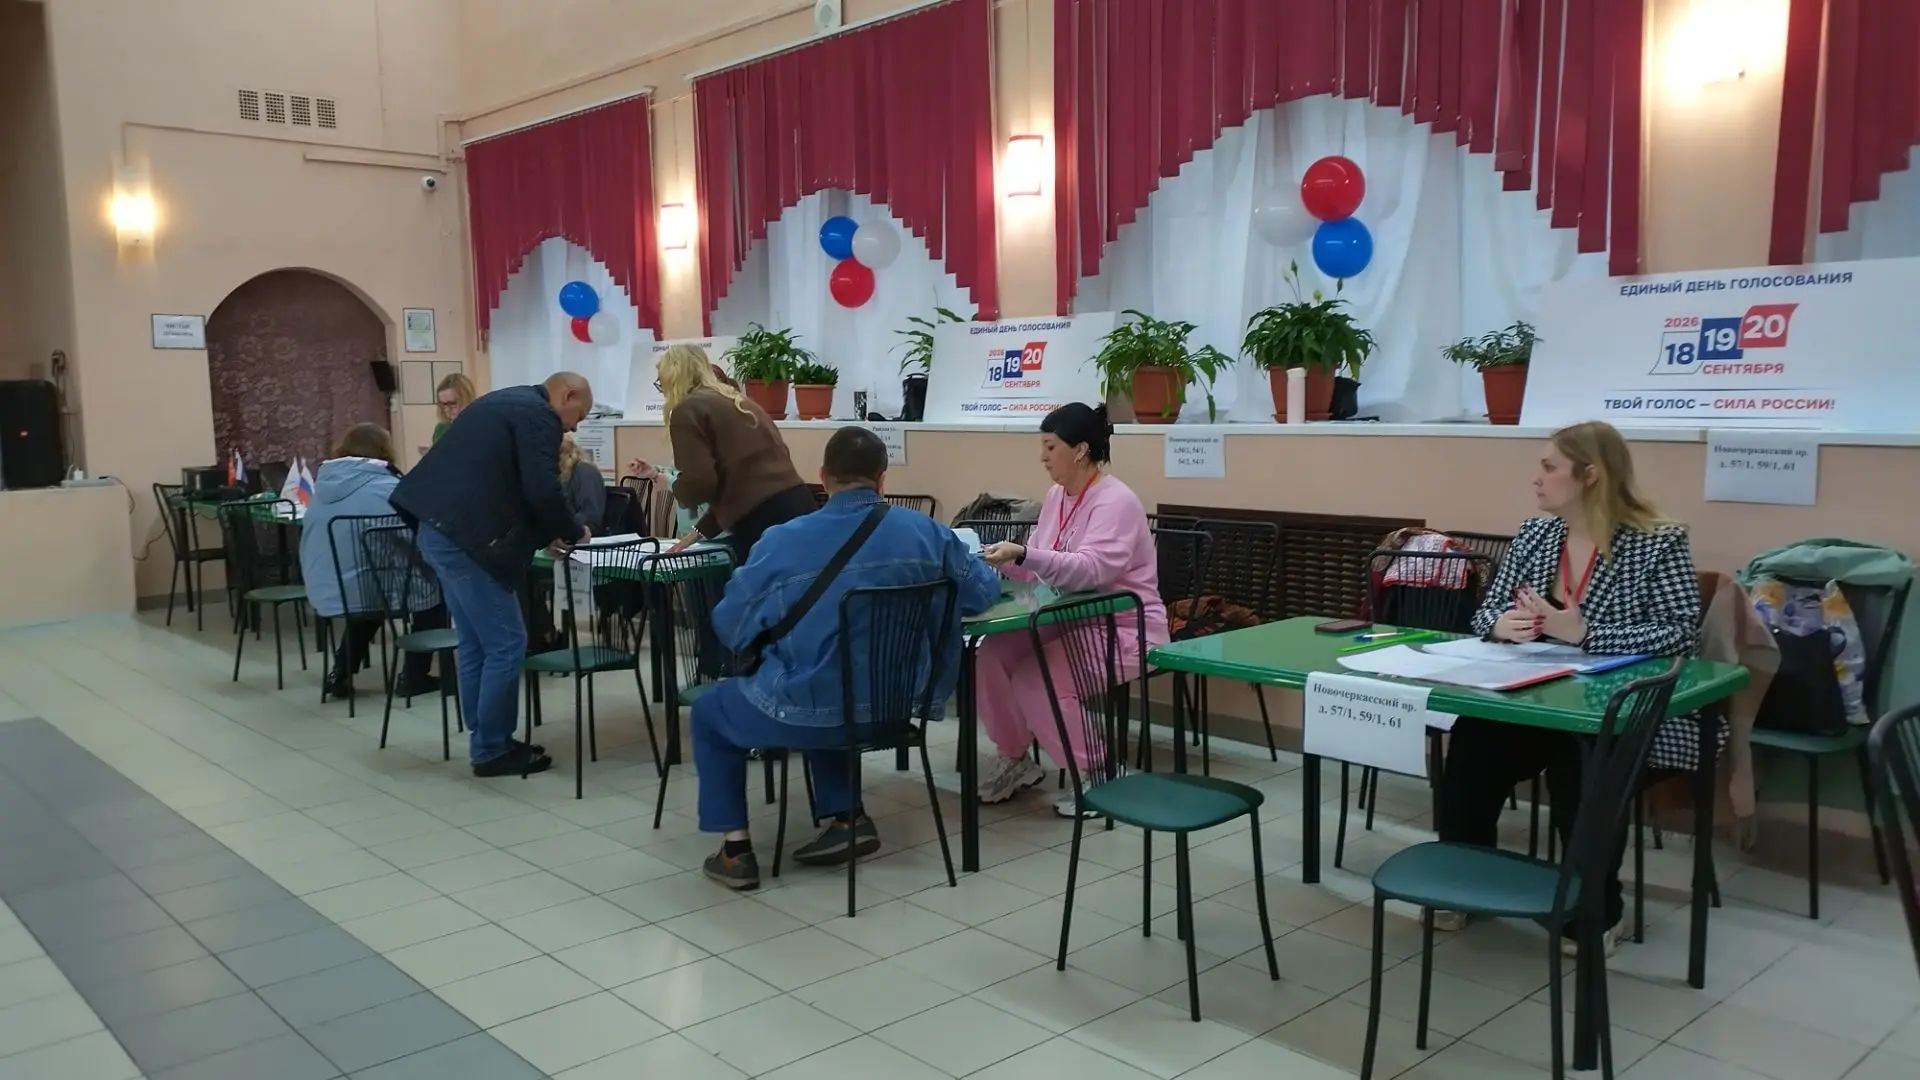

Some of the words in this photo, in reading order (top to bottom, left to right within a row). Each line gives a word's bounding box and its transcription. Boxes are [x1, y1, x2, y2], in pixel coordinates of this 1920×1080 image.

[1620, 280, 1683, 297] ЕДИНЫЙ
[1686, 280, 1726, 294] ДЕНЬ
[1730, 272, 1853, 290] ГОЛОСОВАНИЯ
[969, 326, 998, 335] ЕДИНЫЙ
[999, 324, 1017, 333] ДЕНЬ
[1018, 321, 1071, 331] ГОЛОСОВАНИЯ
[1664, 316, 1699, 328] 2026
[1665, 343, 1695, 366] 18
[1703, 328, 1736, 352] 19
[1743, 314, 1786, 339] 20
[989, 366, 1002, 382] 18
[1005, 356, 1020, 374] 19
[1023, 348, 1042, 365] 20
[1702, 363, 1785, 375] СЕНТЯБРЯ
[1004, 380, 1041, 388] СЕНТЯБРЯ
[961, 402, 978, 411] ТВОЙ
[979, 403, 1002, 412] ГОЛОС
[1008, 403, 1027, 412] СИЛА
[1604, 397, 1642, 410] ТВОЙ
[1645, 398, 1696, 410] ГОЛОС
[1713, 398, 1758, 410] СИЛА
[1760, 398, 1835, 410] РОССИИ!
[1714, 445, 1793, 456] Новочеркасский
[1783, 462, 1796, 471] 61
[1313, 683, 1399, 708] Новочеркасский
[1401, 702, 1417, 713] пр.
[1318, 705, 1328, 715] д.
[1331, 705, 1357, 720] 57/1,
[1360, 710, 1386, 726] 59/1,
[1389, 716, 1402, 729] 61
